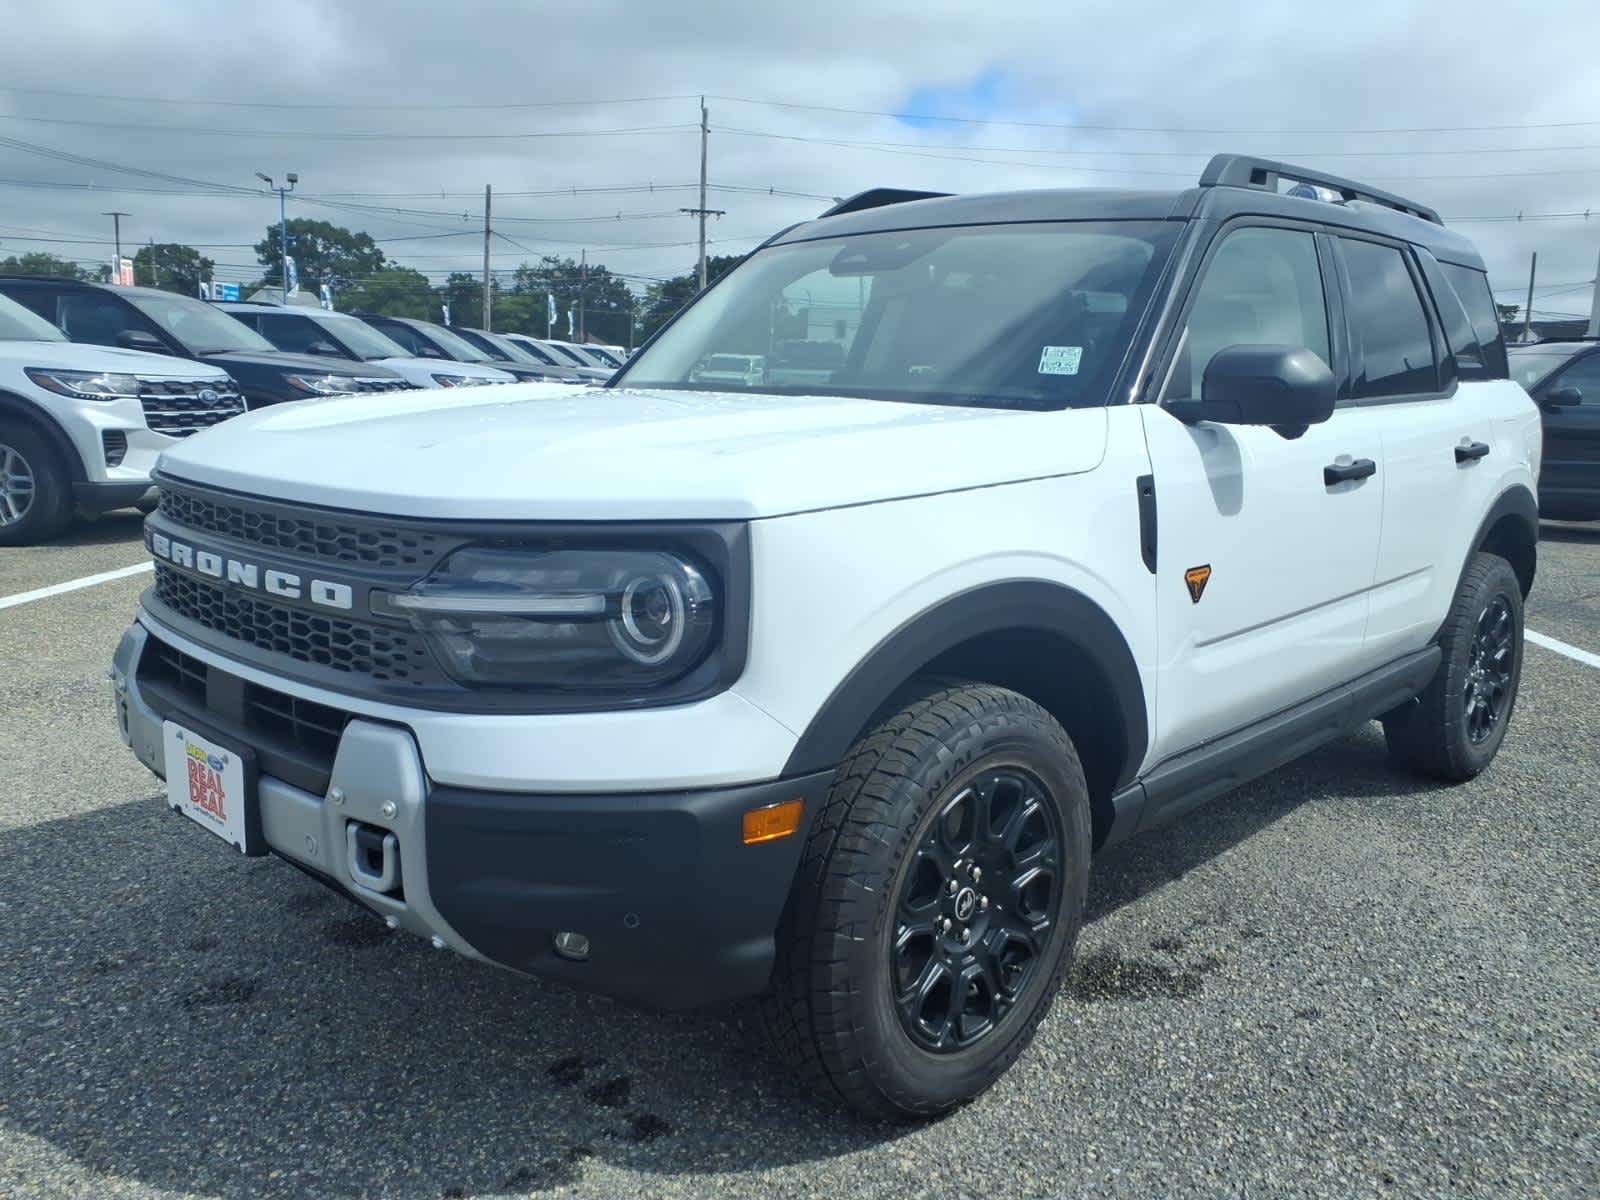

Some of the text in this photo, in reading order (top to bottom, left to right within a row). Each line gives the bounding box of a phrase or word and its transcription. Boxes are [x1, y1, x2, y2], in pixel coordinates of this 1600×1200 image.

[153, 533, 352, 609] BRONCO
[188, 758, 225, 798] REAL
[190, 782, 227, 821] DEAL
